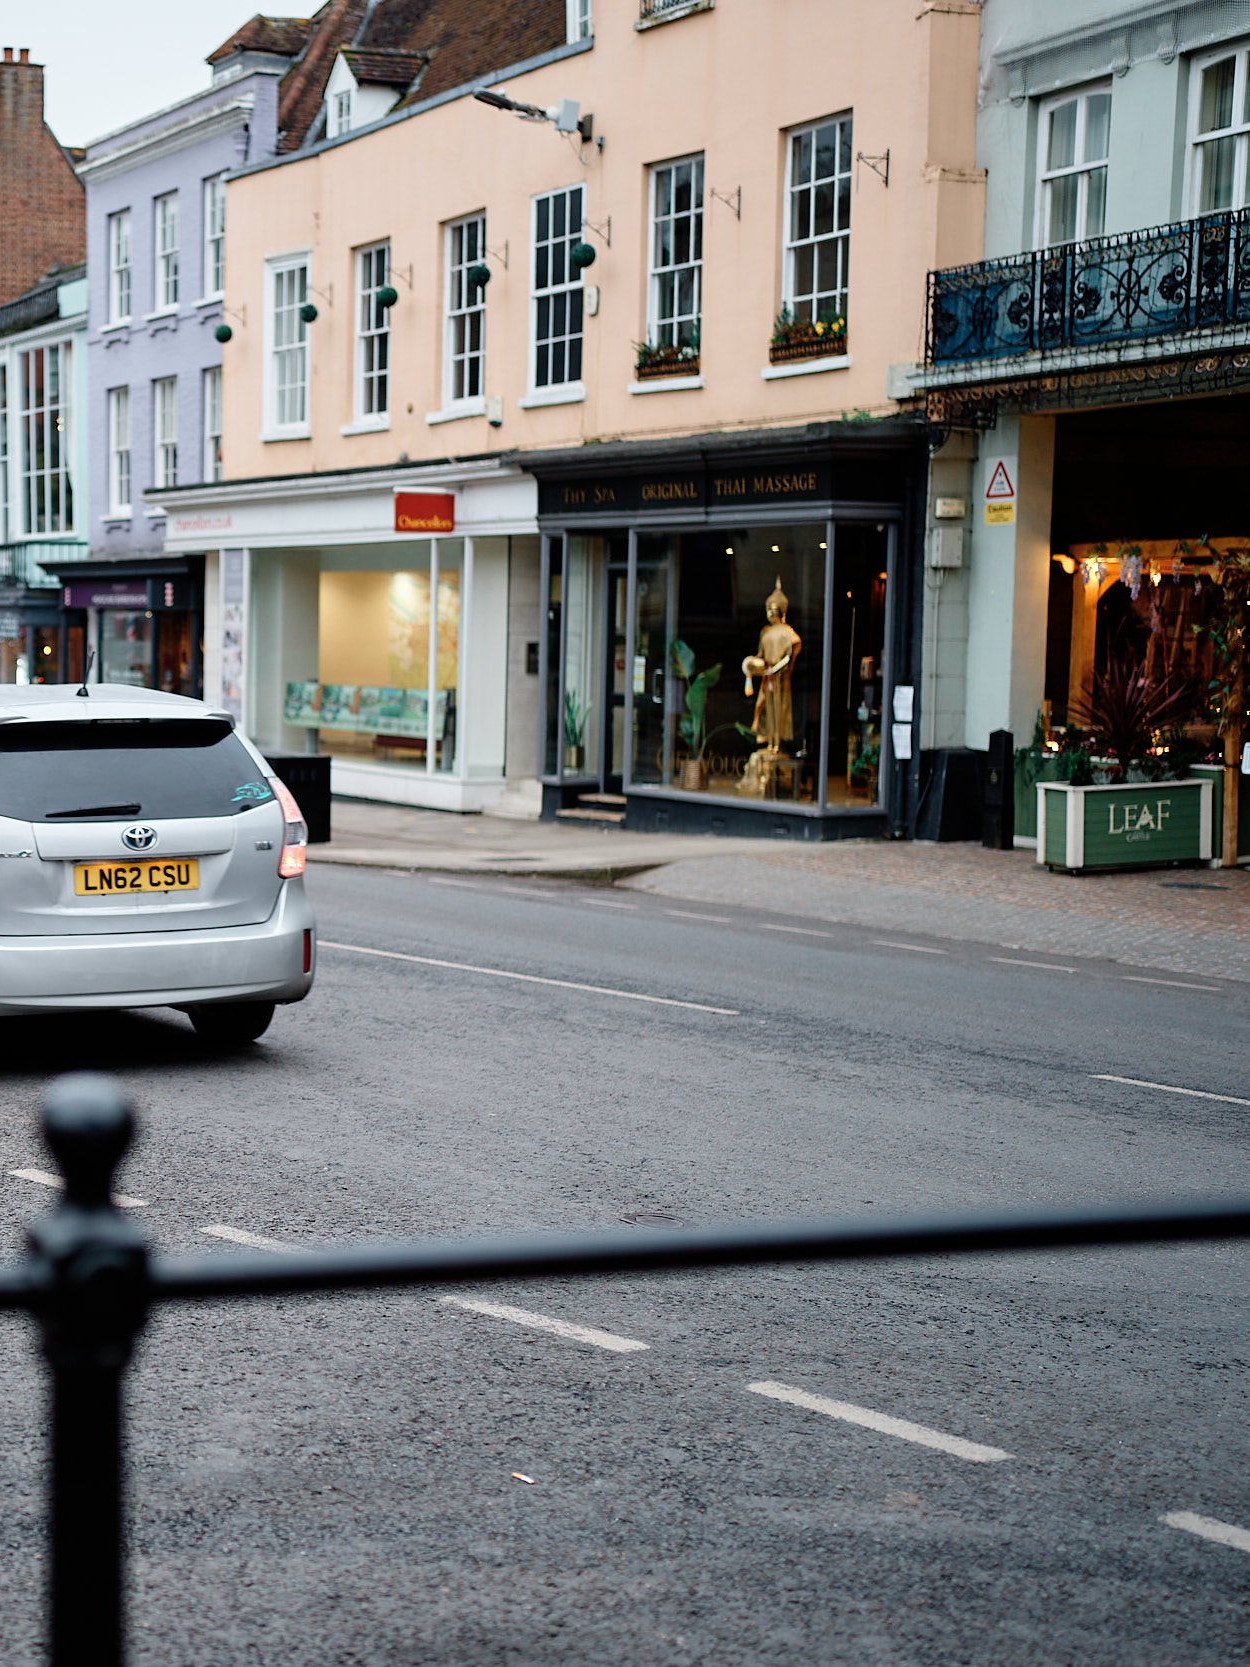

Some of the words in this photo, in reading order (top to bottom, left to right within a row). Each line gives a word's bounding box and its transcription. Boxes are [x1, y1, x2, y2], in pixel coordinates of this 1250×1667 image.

[642, 480, 697, 501] ORIGINAL
[714, 478, 746, 497] THAI
[753, 472, 817, 495] MASSAGE
[1108, 799, 1172, 835] LEAF
[83, 866, 142, 891] LN62
[150, 864, 190, 887] CSU
